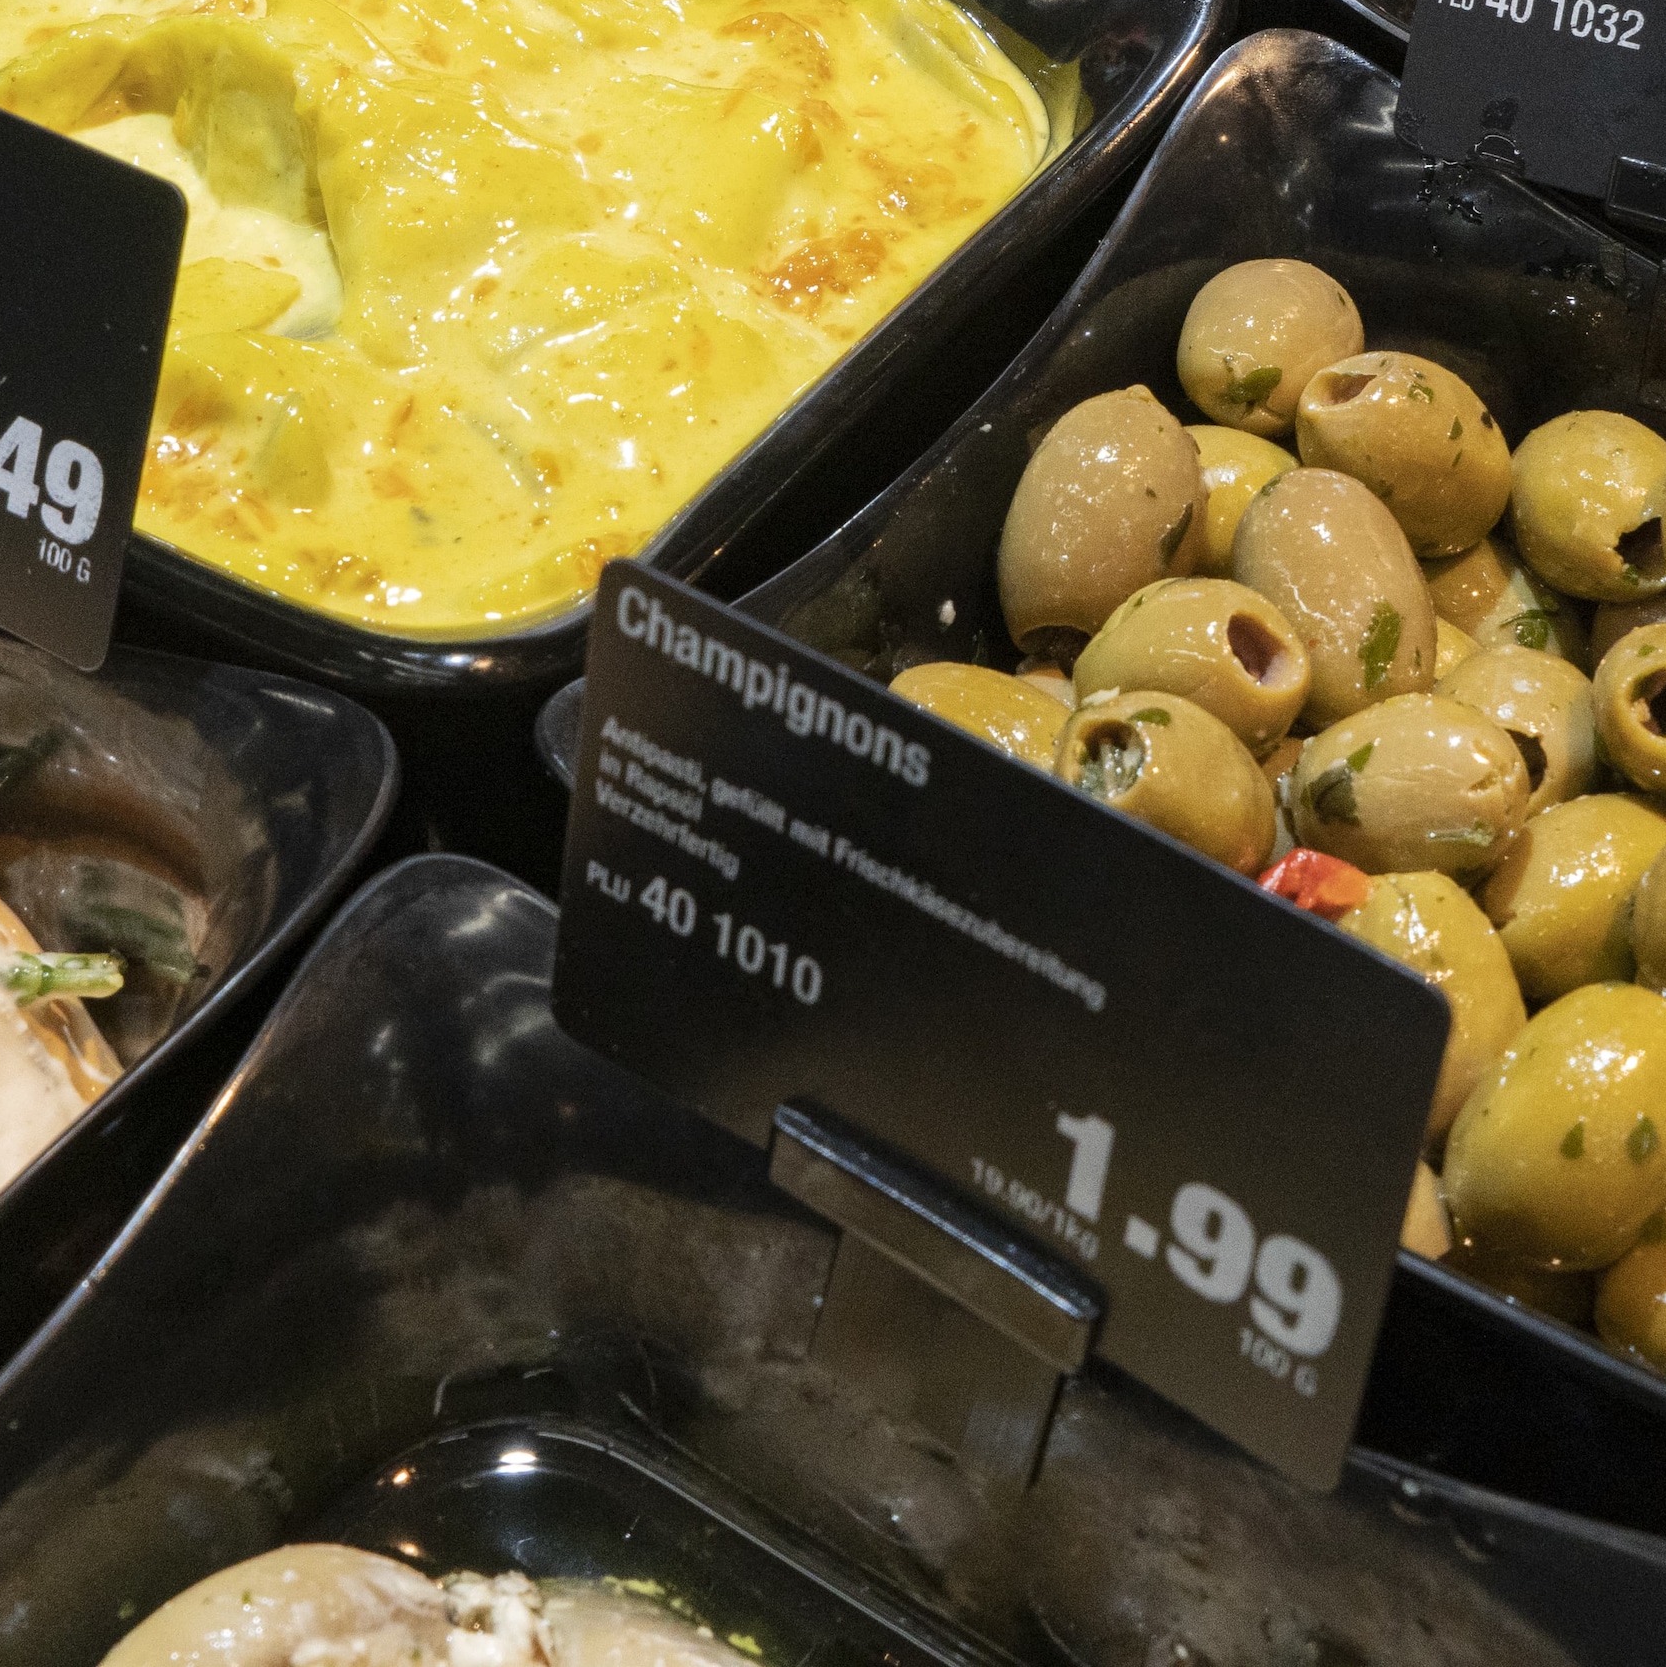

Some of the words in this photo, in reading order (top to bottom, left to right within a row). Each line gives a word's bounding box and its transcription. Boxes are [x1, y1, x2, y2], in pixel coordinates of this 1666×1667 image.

[38, 537, 71, 574] 100
[617, 586, 931, 787] Champignons
[596, 778, 740, 881] Verzehrfertig
[625, 761, 704, 821] Rapsöl
[585, 860, 632, 904] PLU
[639, 875, 697, 937] 40
[713, 912, 823, 1005] 1010
[1057, 1112, 1342, 1358] 1.99
